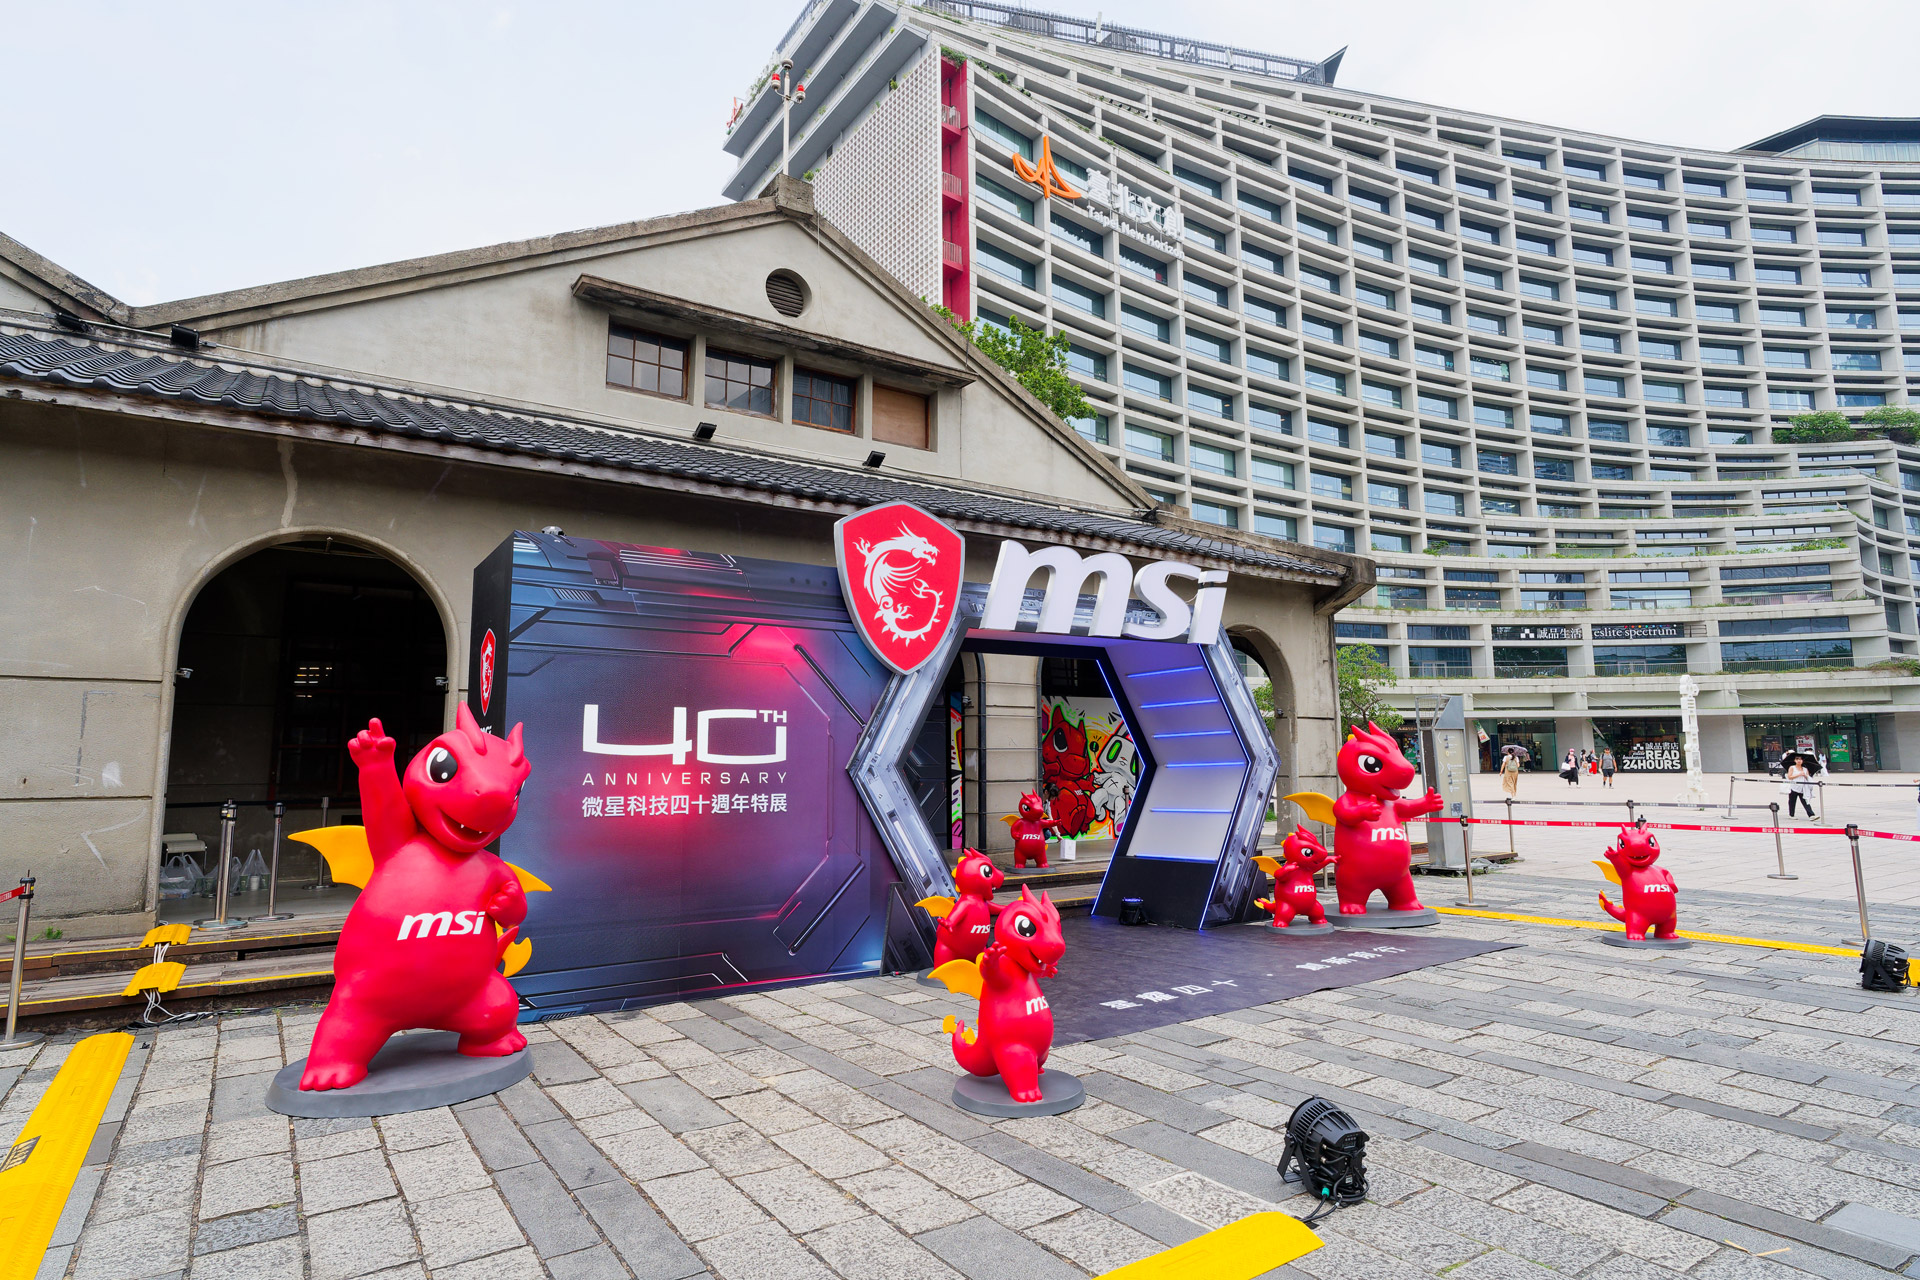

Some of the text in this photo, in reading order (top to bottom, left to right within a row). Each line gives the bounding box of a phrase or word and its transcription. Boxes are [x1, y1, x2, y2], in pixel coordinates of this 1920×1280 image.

[1086, 168, 1184, 240] 臺北文創
[1087, 205, 1185, 260] Taipei New Horizon
[980, 540, 1229, 645] msi
[1536, 627, 1583, 639] 誠品生活
[1594, 627, 1677, 640] eslite spectrum
[1645, 750, 1680, 760] READ
[1622, 760, 1681, 770] 24HOURS
[582, 772, 787, 785] ANNIVERSARY
[582, 794, 788, 818] 微星科技四十週年特展
[1371, 827, 1408, 842] msi
[1294, 884, 1315, 894] msi
[1643, 883, 1670, 893] msi
[397, 910, 486, 941] msi
[970, 924, 991, 934] ms
[1025, 995, 1050, 1015] ms
